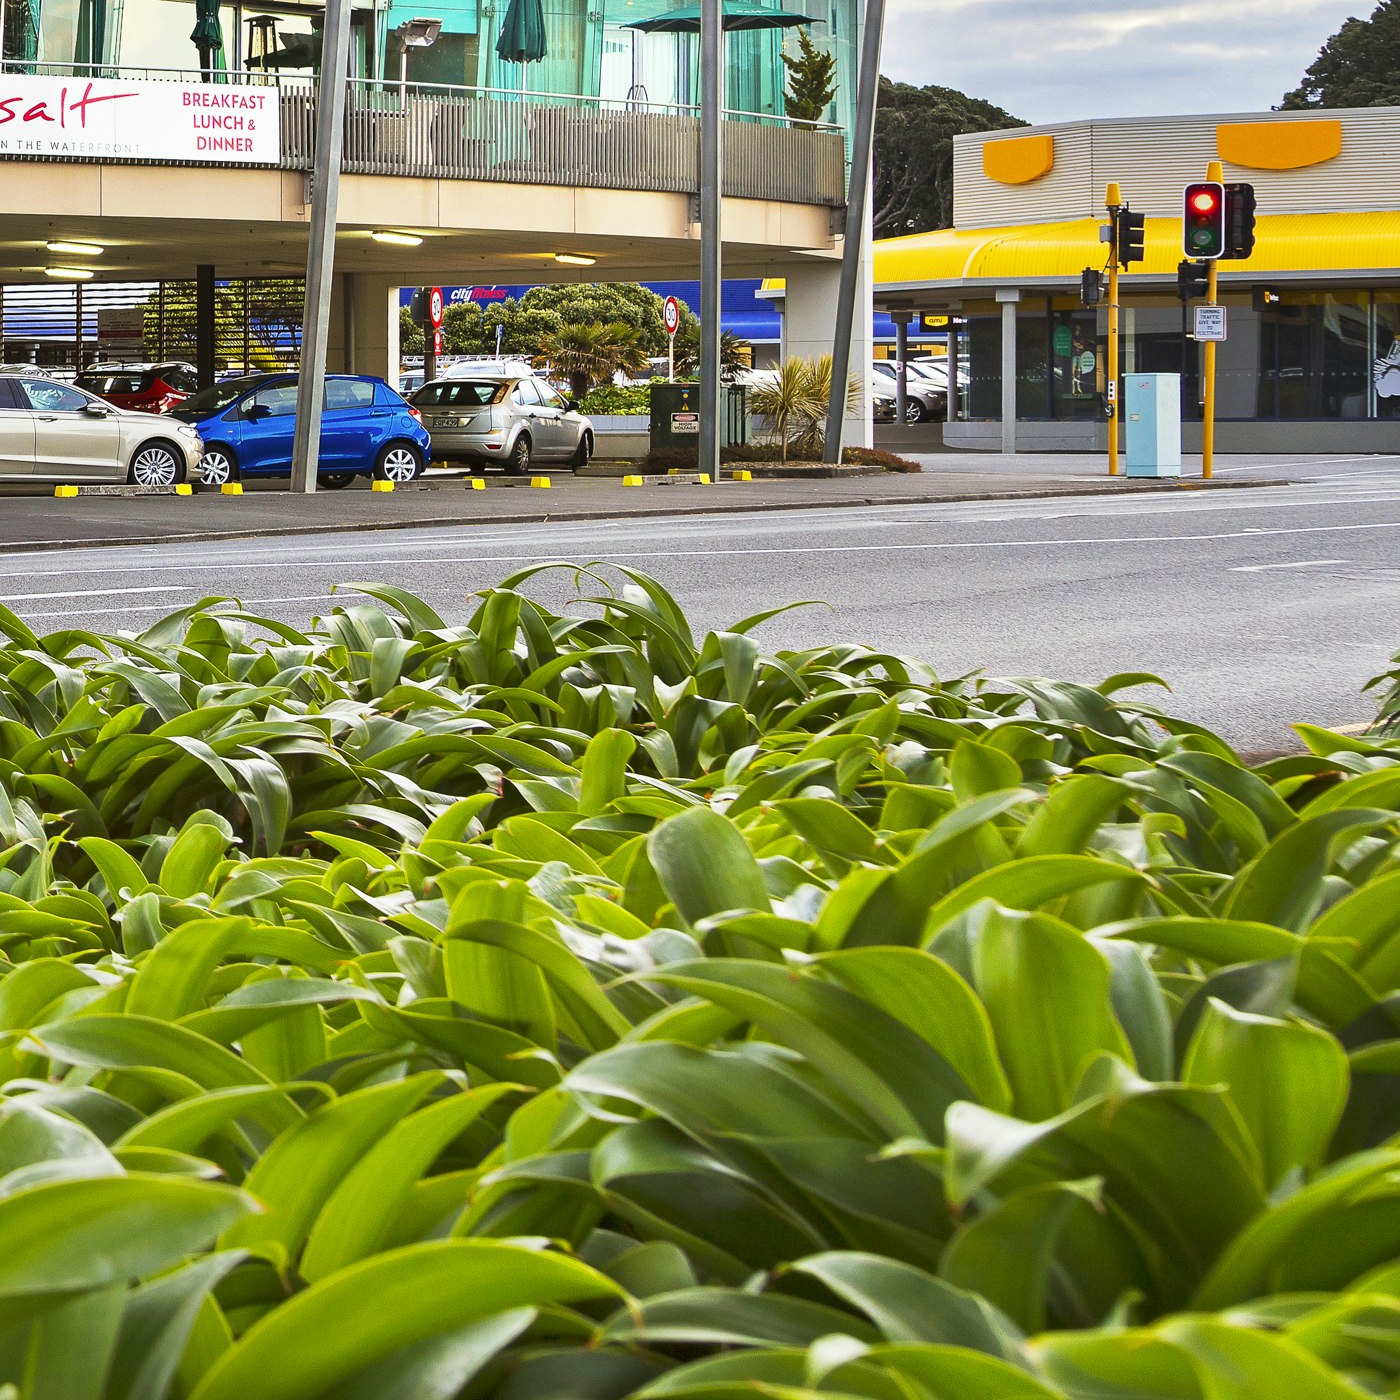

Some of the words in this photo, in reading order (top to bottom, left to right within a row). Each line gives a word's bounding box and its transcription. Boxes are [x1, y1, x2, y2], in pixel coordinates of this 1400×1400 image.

[182, 92, 266, 109] BREAKFAST
[193, 114, 243, 130] LUNCH
[247, 119, 256, 131] &
[16, 140, 42, 151] THE
[50, 141, 141, 154] WATERFRONT
[196, 136, 253, 152] DINNER
[667, 308, 675, 321] 30
